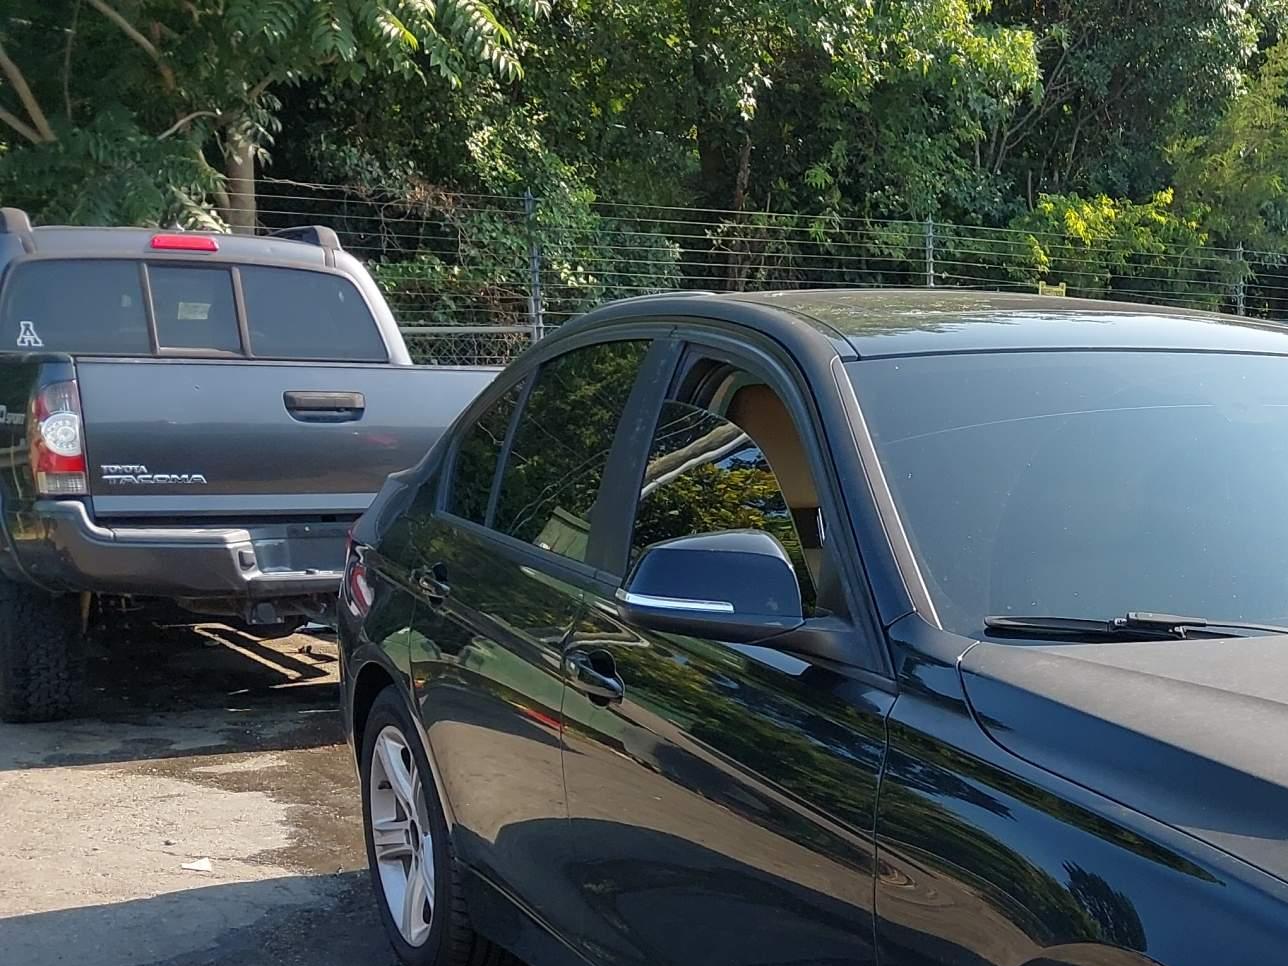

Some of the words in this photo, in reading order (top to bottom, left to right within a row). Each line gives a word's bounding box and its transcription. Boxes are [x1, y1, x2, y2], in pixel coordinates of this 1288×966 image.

[17, 321, 44, 346] A
[101, 464, 148, 474] TOYOTA
[102, 475, 207, 484] TACOMA
